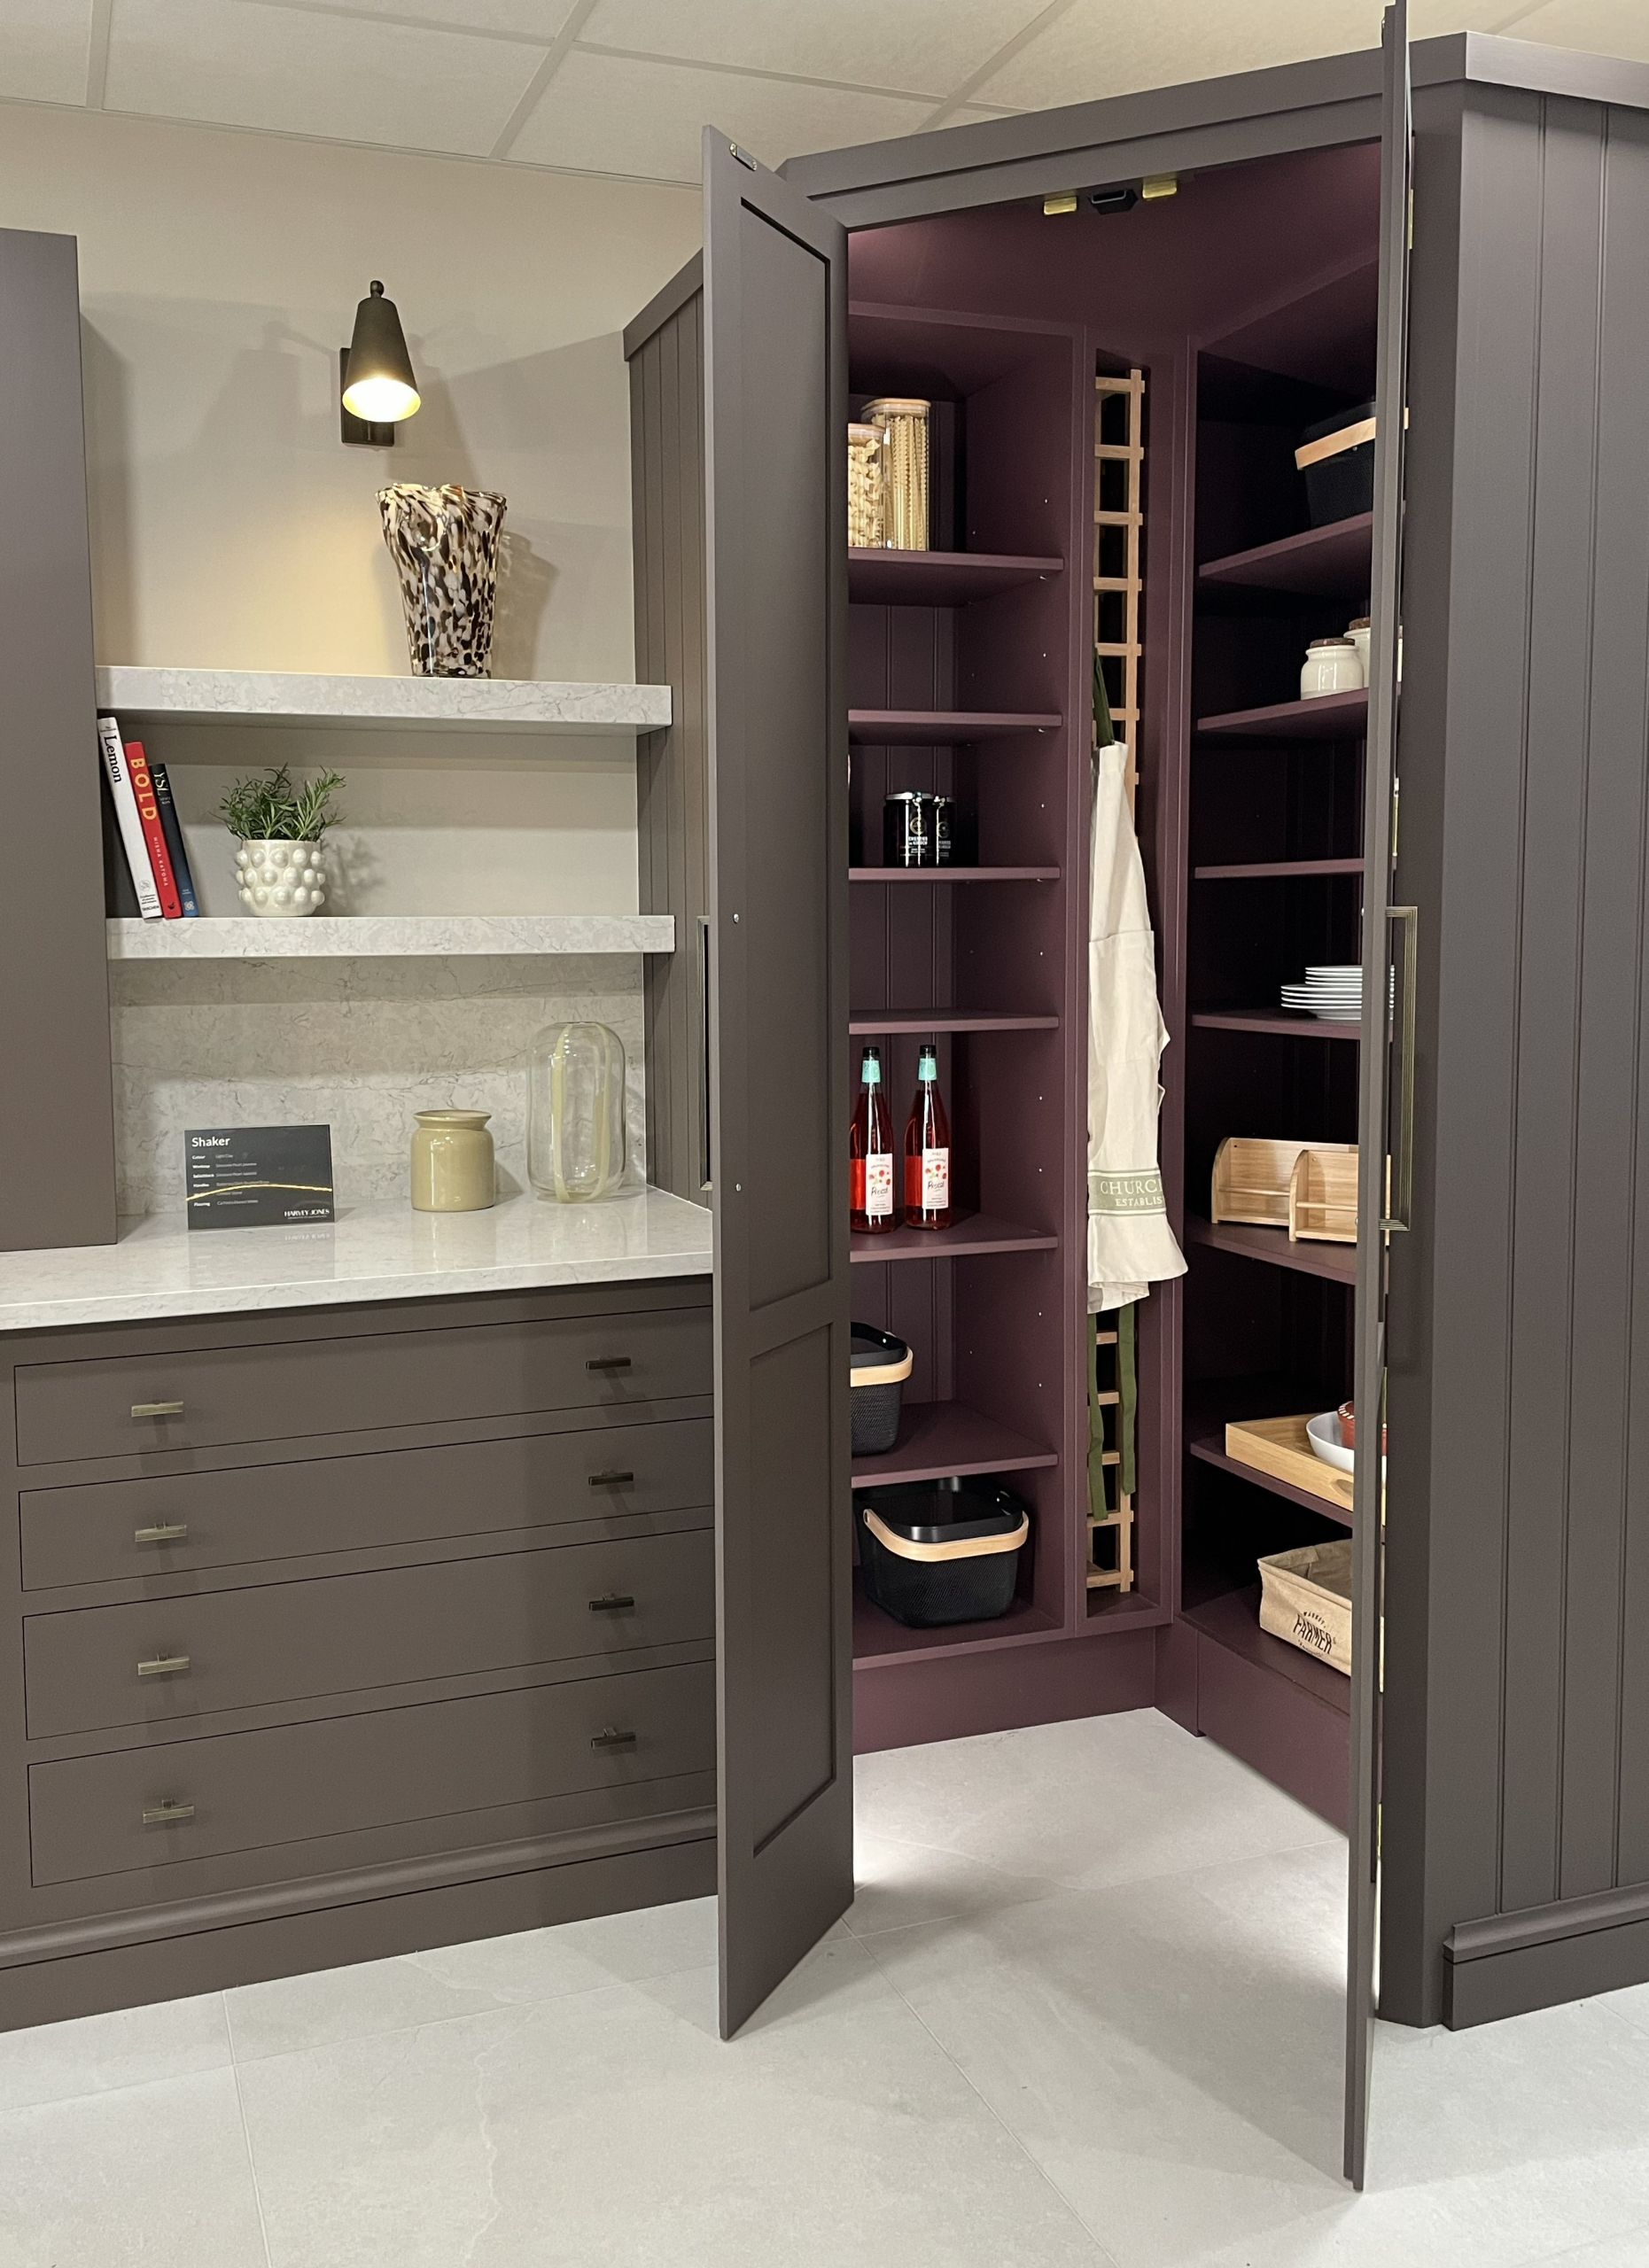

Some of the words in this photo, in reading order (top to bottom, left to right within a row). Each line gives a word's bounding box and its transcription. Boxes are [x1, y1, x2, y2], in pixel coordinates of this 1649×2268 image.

[104, 735, 122, 784] Lemon
[130, 757, 157, 820] BOLD
[153, 772, 169, 796] YSL
[191, 1136, 231, 1147] Shaker
[1293, 1613, 1332, 1654] FARMER
